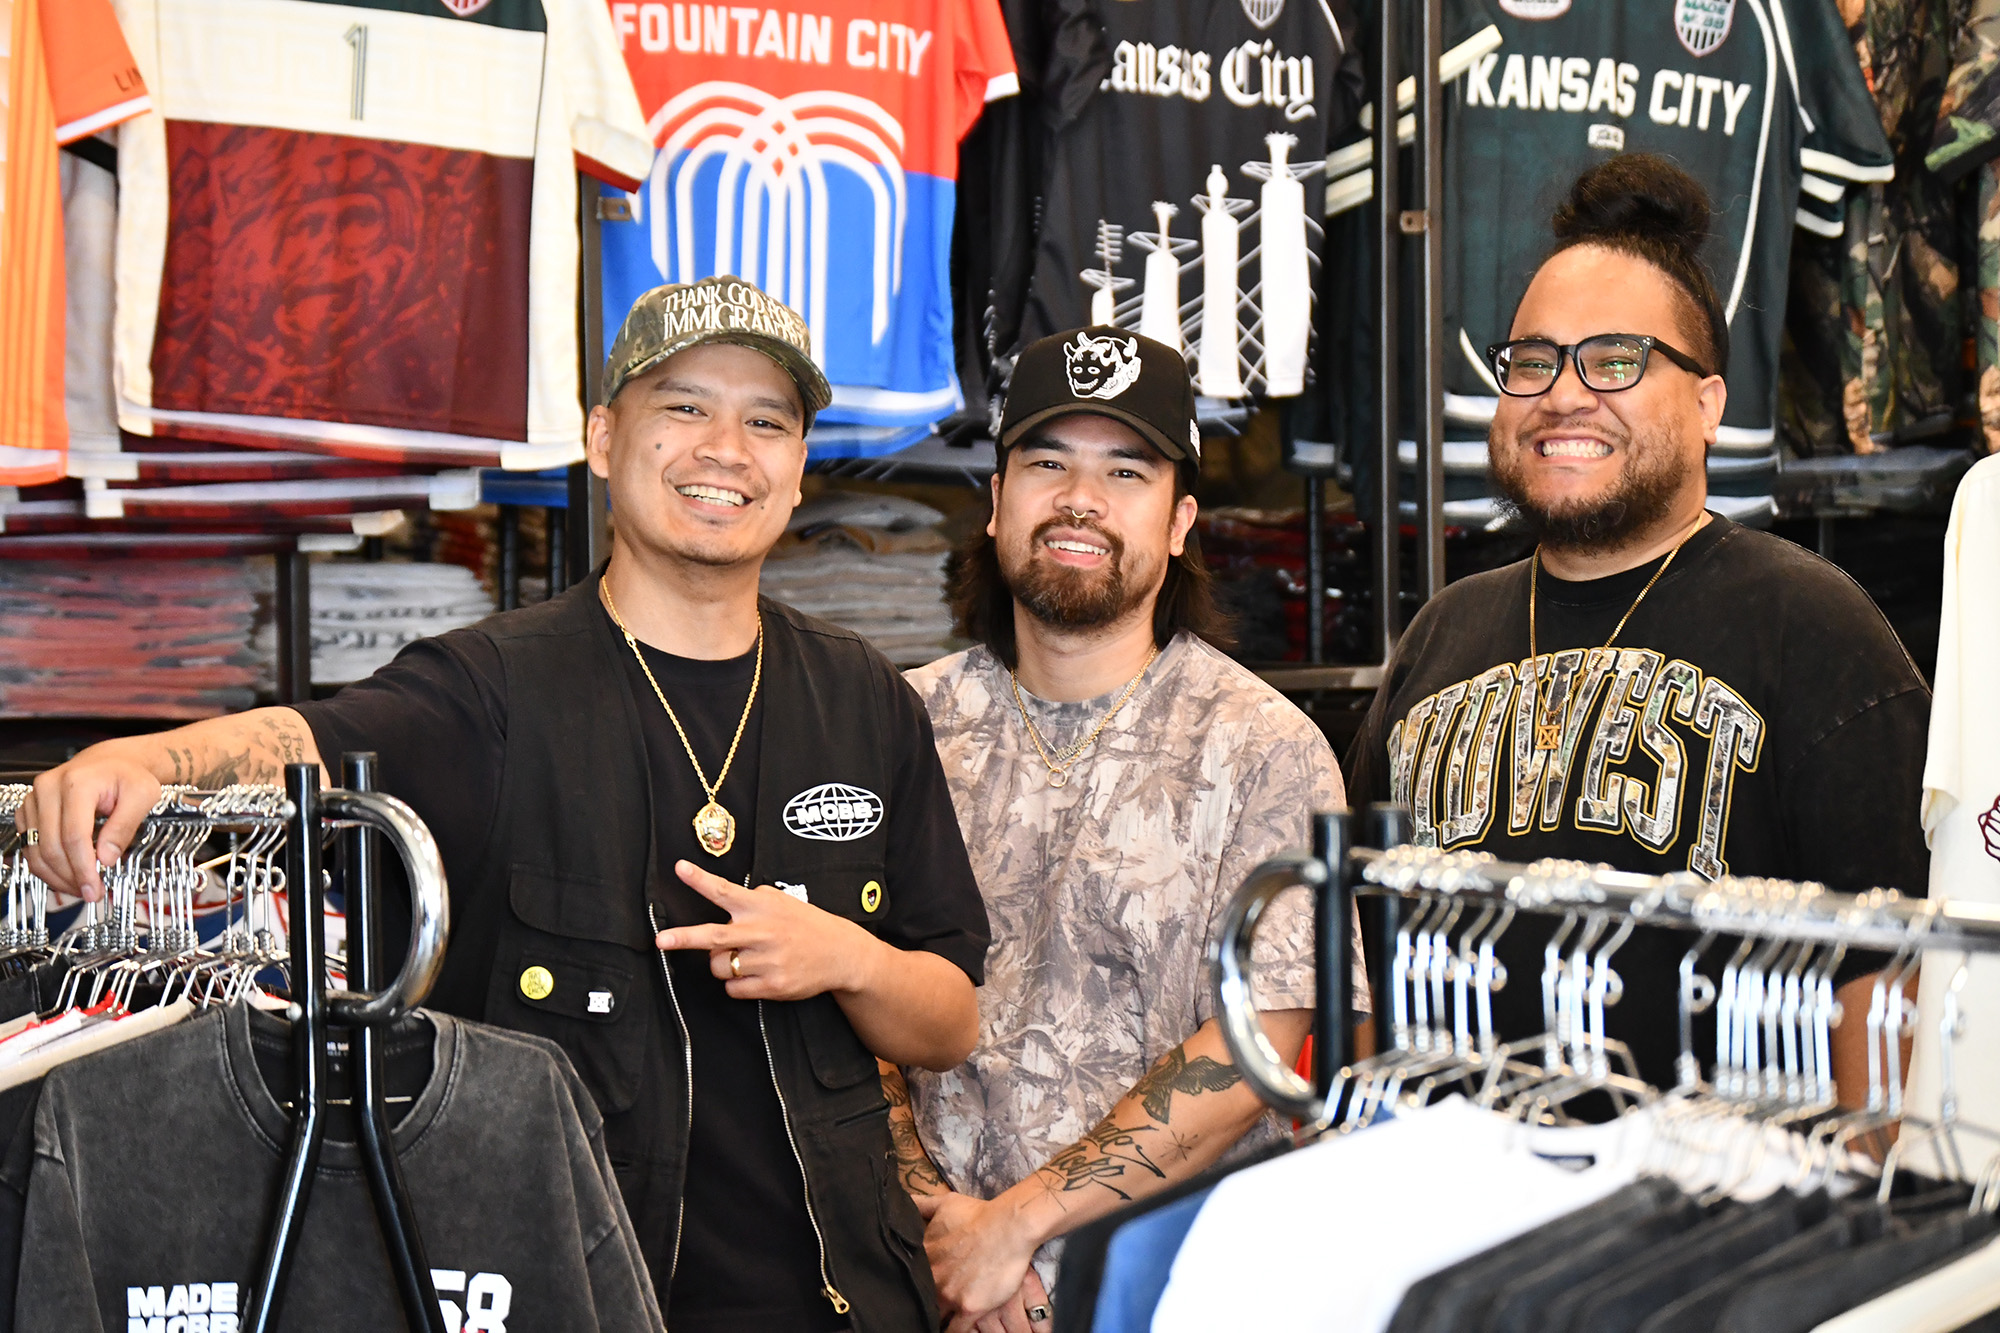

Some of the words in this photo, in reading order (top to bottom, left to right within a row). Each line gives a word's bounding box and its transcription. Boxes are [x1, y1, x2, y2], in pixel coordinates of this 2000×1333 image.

[342, 23, 368, 121] 1
[612, 2, 832, 66] FOUNTAIN
[846, 18, 933, 78] CITY
[1220, 38, 1317, 122] City
[1466, 53, 1640, 119] KANSAS
[1648, 68, 1752, 136] CITY
[662, 283, 723, 313] THANK
[727, 282, 765, 315] GOD
[1387, 646, 1766, 883] MIDWEST
[795, 801, 874, 826] MOBB
[127, 1281, 240, 1318] MADE
